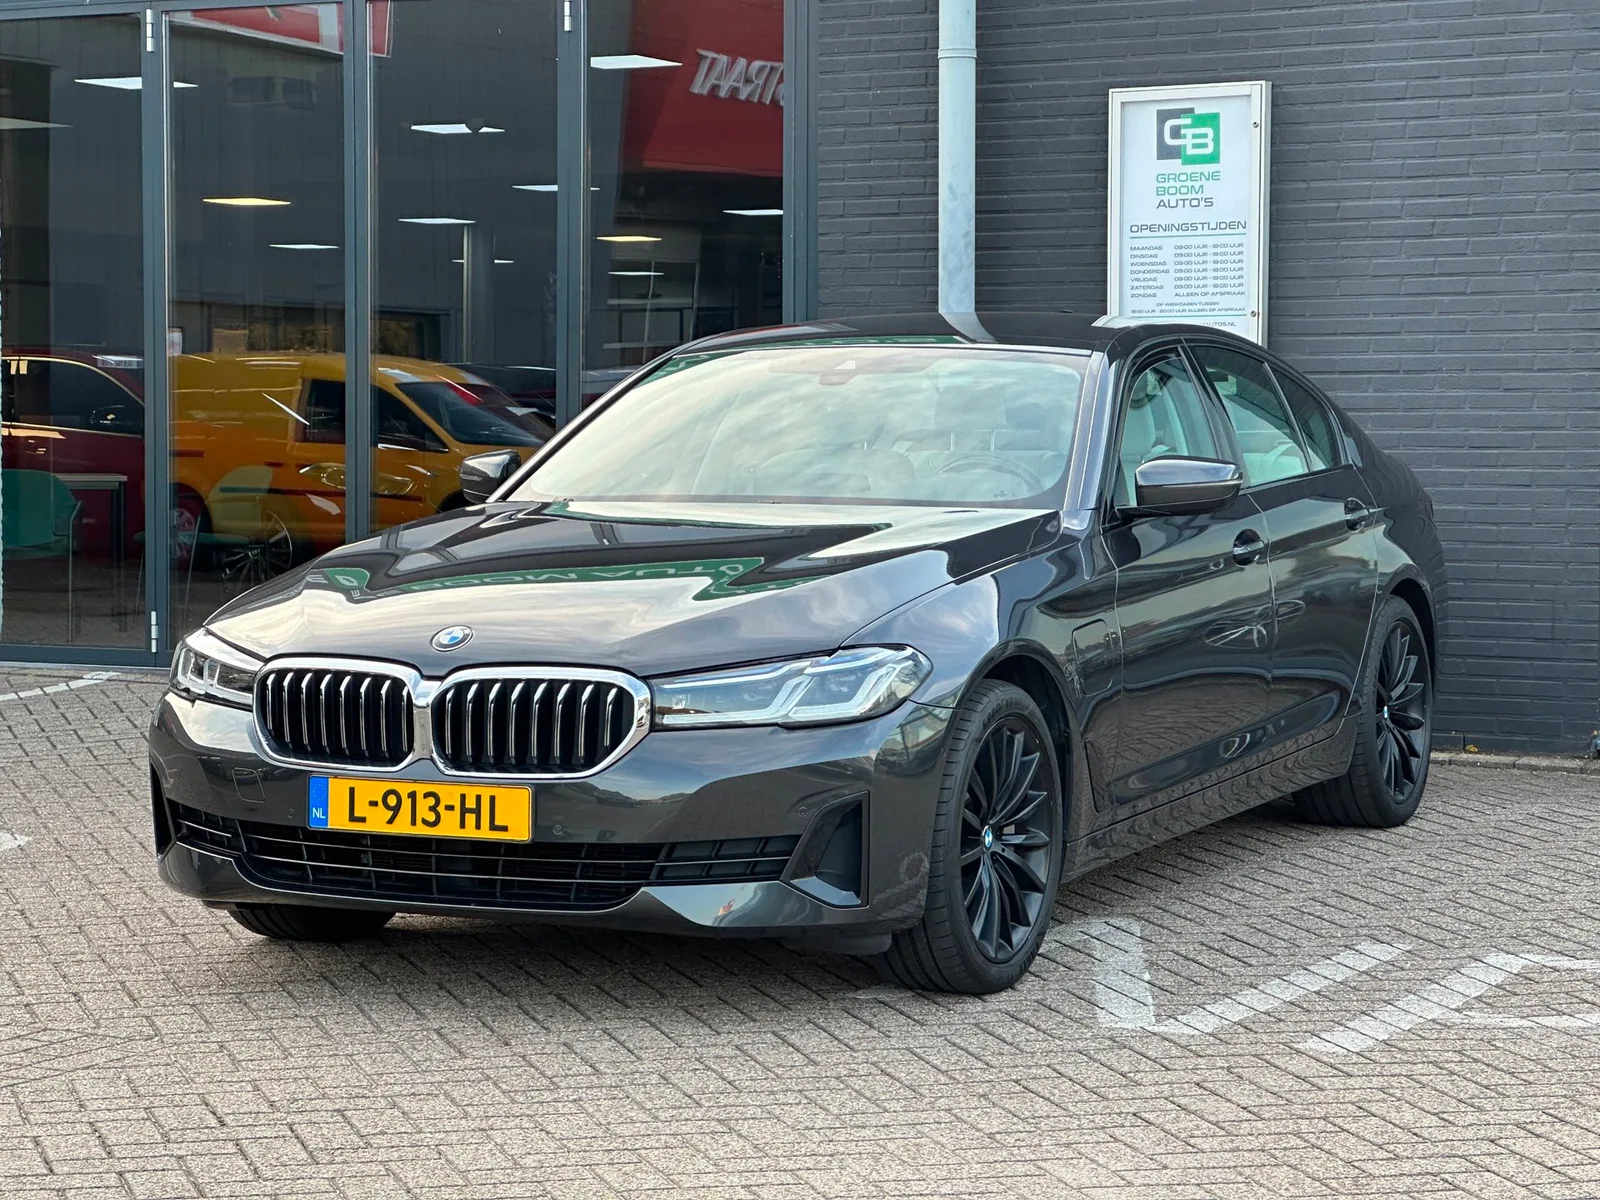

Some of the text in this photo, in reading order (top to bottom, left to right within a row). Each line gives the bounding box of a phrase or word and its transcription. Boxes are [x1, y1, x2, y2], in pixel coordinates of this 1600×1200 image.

[1156, 171, 1221, 183] GROENE
[1156, 185, 1204, 196] BOOM
[1156, 197, 1214, 209] AUTO'S
[1130, 221, 1247, 233] OPENINGSTIJDEN
[312, 807, 325, 819] NL
[348, 786, 509, 832] L-913-HL
